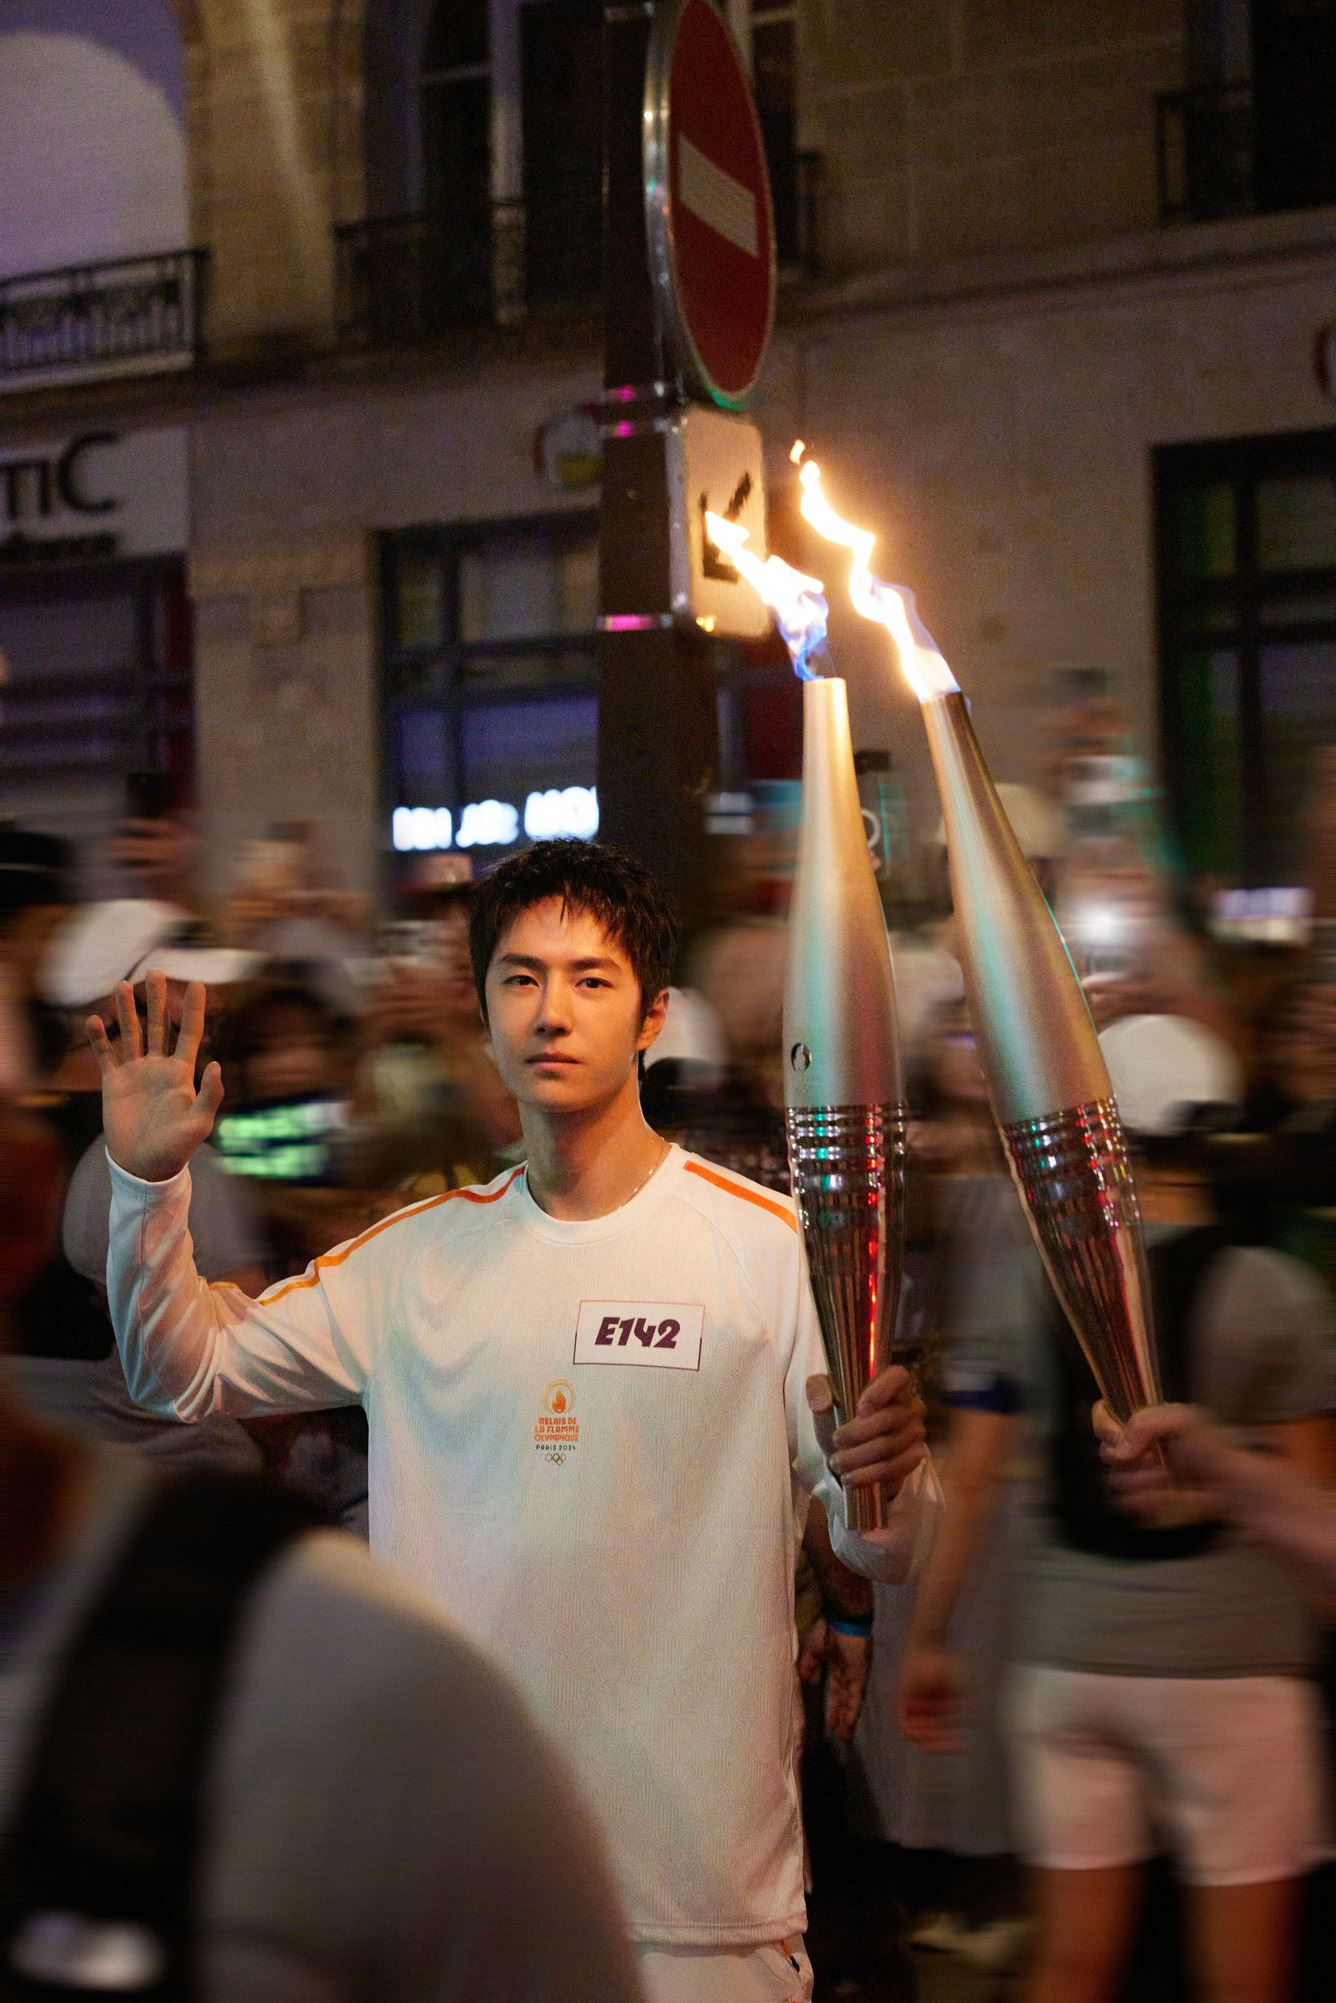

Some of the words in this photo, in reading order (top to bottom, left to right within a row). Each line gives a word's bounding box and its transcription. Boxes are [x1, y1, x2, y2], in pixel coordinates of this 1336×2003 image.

[594, 1316, 681, 1349] E142
[538, 1416, 567, 1425] RELAIS
[568, 1416, 577, 1425] DE
[547, 1425, 579, 1433] FLAMME
